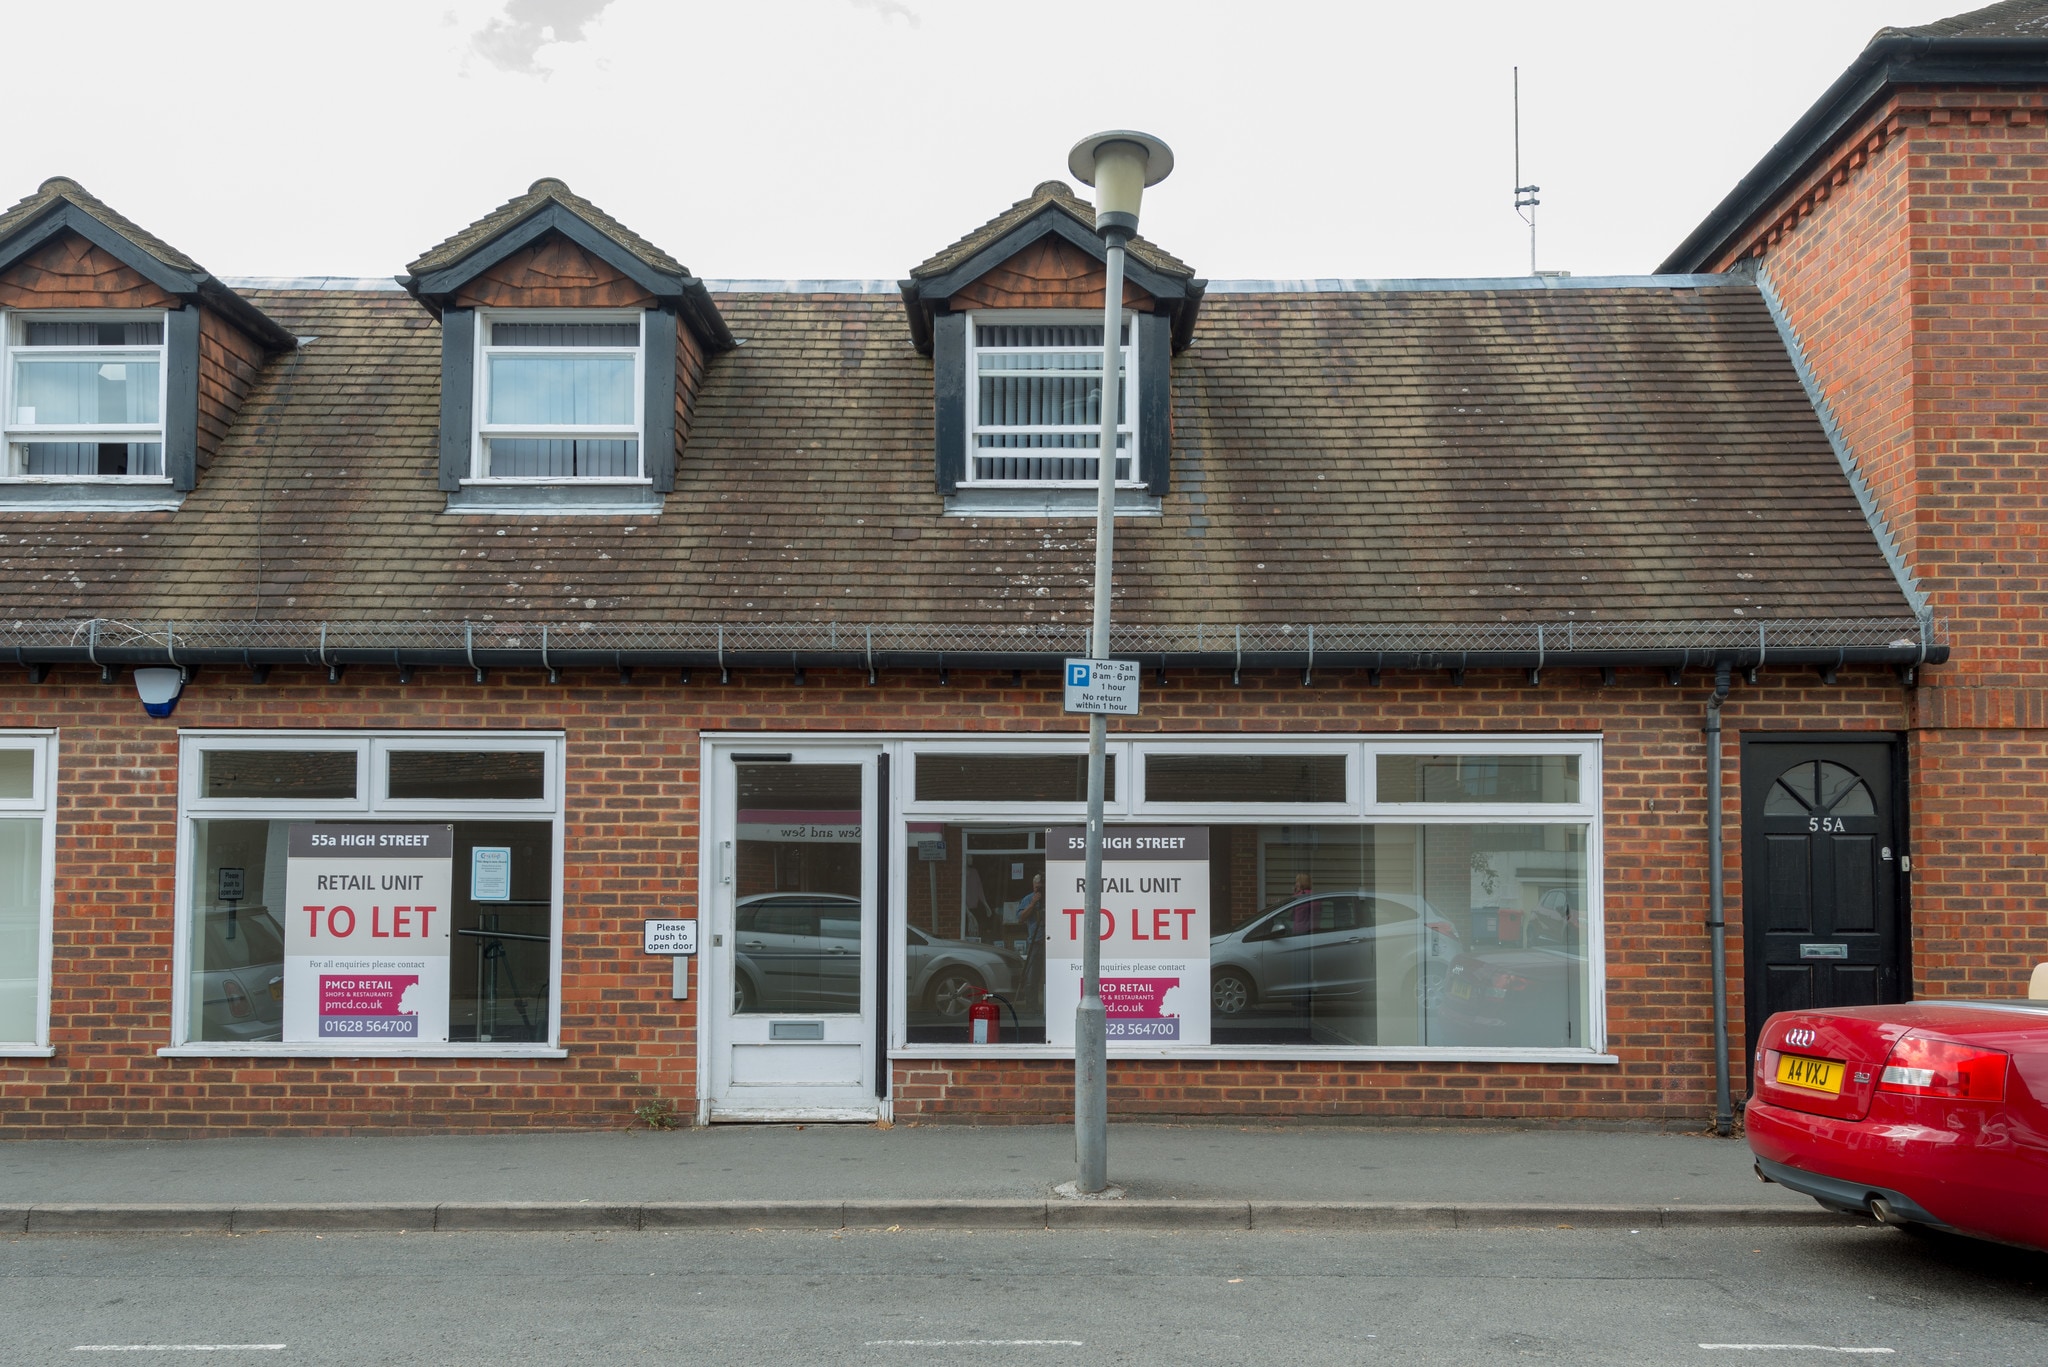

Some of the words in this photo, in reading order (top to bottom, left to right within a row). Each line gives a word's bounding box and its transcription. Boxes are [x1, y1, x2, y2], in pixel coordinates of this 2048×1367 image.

[1095, 662, 1113, 670] Mon
[1090, 819, 1096, 832] 1
[1808, 817, 1846, 832] 55A
[311, 834, 337, 847] 55a
[340, 834, 375, 847] HIGH
[379, 834, 430, 847] STREET
[1068, 837, 1087, 849] 55
[1136, 837, 1186, 849] STREET
[317, 874, 376, 891] RETAIL
[381, 874, 423, 891] UNIT
[1076, 877, 1134, 893] RTAIL
[1140, 877, 1181, 893] UNIT
[303, 905, 356, 938] TO
[371, 905, 437, 938] LET
[656, 923, 686, 931] Please
[1132, 908, 1196, 941] LET
[653, 933, 676, 942] push
[648, 943, 670, 951] open
[672, 942, 694, 950] door
[309, 960, 321, 968] For
[323, 960, 334, 968] all
[335, 960, 370, 970] enquiries
[371, 960, 396, 970] please
[397, 961, 425, 969] contact
[1100, 963, 1131, 973] nquiries
[1132, 963, 1157, 973] please
[1158, 963, 1186, 972] contact
[325, 980, 356, 990] PMCD
[358, 980, 393, 990] RETAIL
[1119, 983, 1155, 993] RETAIL
[325, 1000, 383, 1011] pmcd.co.uk
[1105, 1002, 1145, 1013] cd.co.uk
[324, 1020, 363, 1032] 01628
[366, 1020, 413, 1032] 564700
[1128, 1023, 1174, 1035] 564700
[1787, 1059, 1804, 1082] A4
[1805, 1061, 1831, 1086] VXJ
